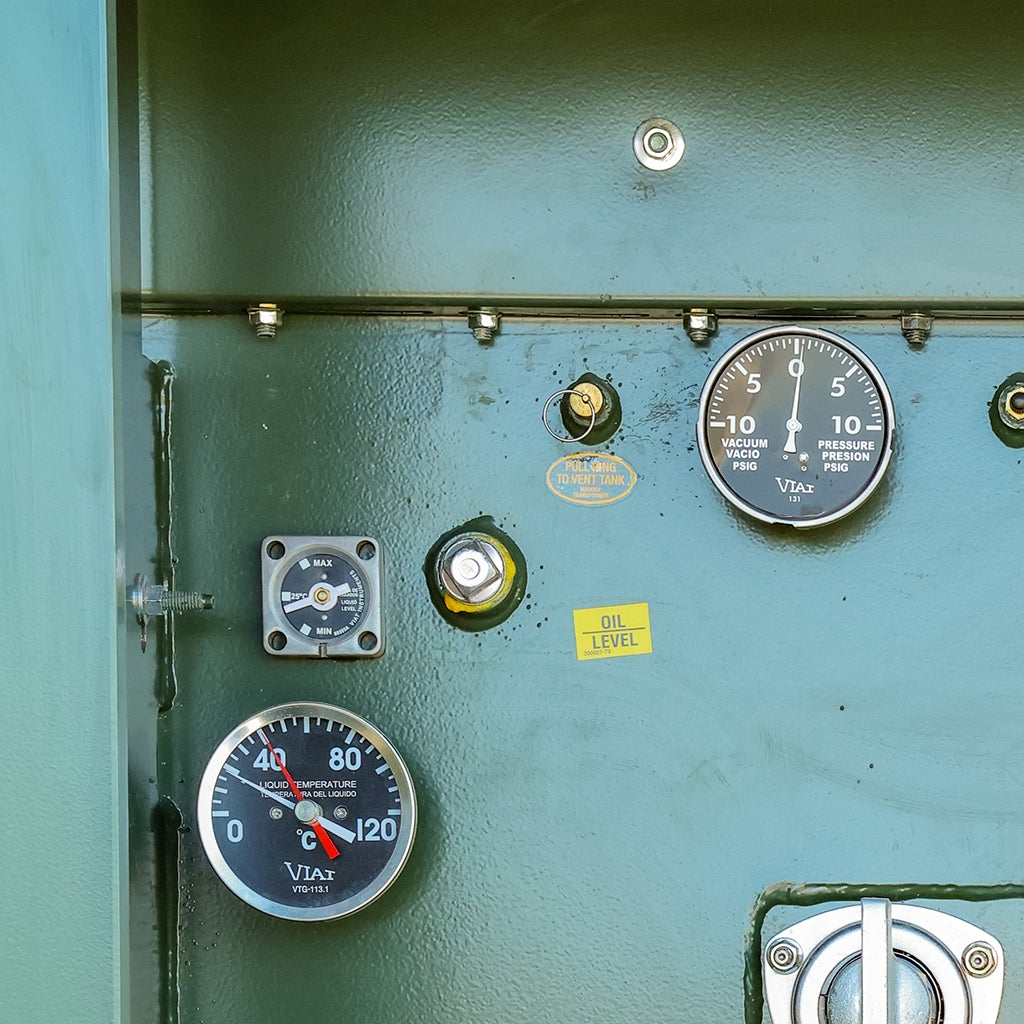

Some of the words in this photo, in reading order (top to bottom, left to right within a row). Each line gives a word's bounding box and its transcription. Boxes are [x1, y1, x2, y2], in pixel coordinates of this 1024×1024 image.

[746, 374, 761, 393] 5
[831, 377, 845, 397] 5
[726, 416, 755, 434] 10
[832, 416, 861, 434] 10
[722, 438, 768, 448] VACUUM
[818, 441, 875, 450] PRESSURE
[726, 450, 760, 459] VACIO
[822, 452, 870, 461] PRESION
[565, 461, 589, 472] PULL
[733, 462, 757, 471] PSIG
[824, 463, 848, 472] PSIG
[572, 474, 596, 484] VENT
[600, 474, 624, 485] TANK
[601, 614, 626, 629] OIL
[592, 633, 638, 649] LEVEL
[253, 748, 287, 771] 40
[329, 747, 361, 771] 80
[227, 819, 243, 843] 0
[357, 818, 397, 842] 120
